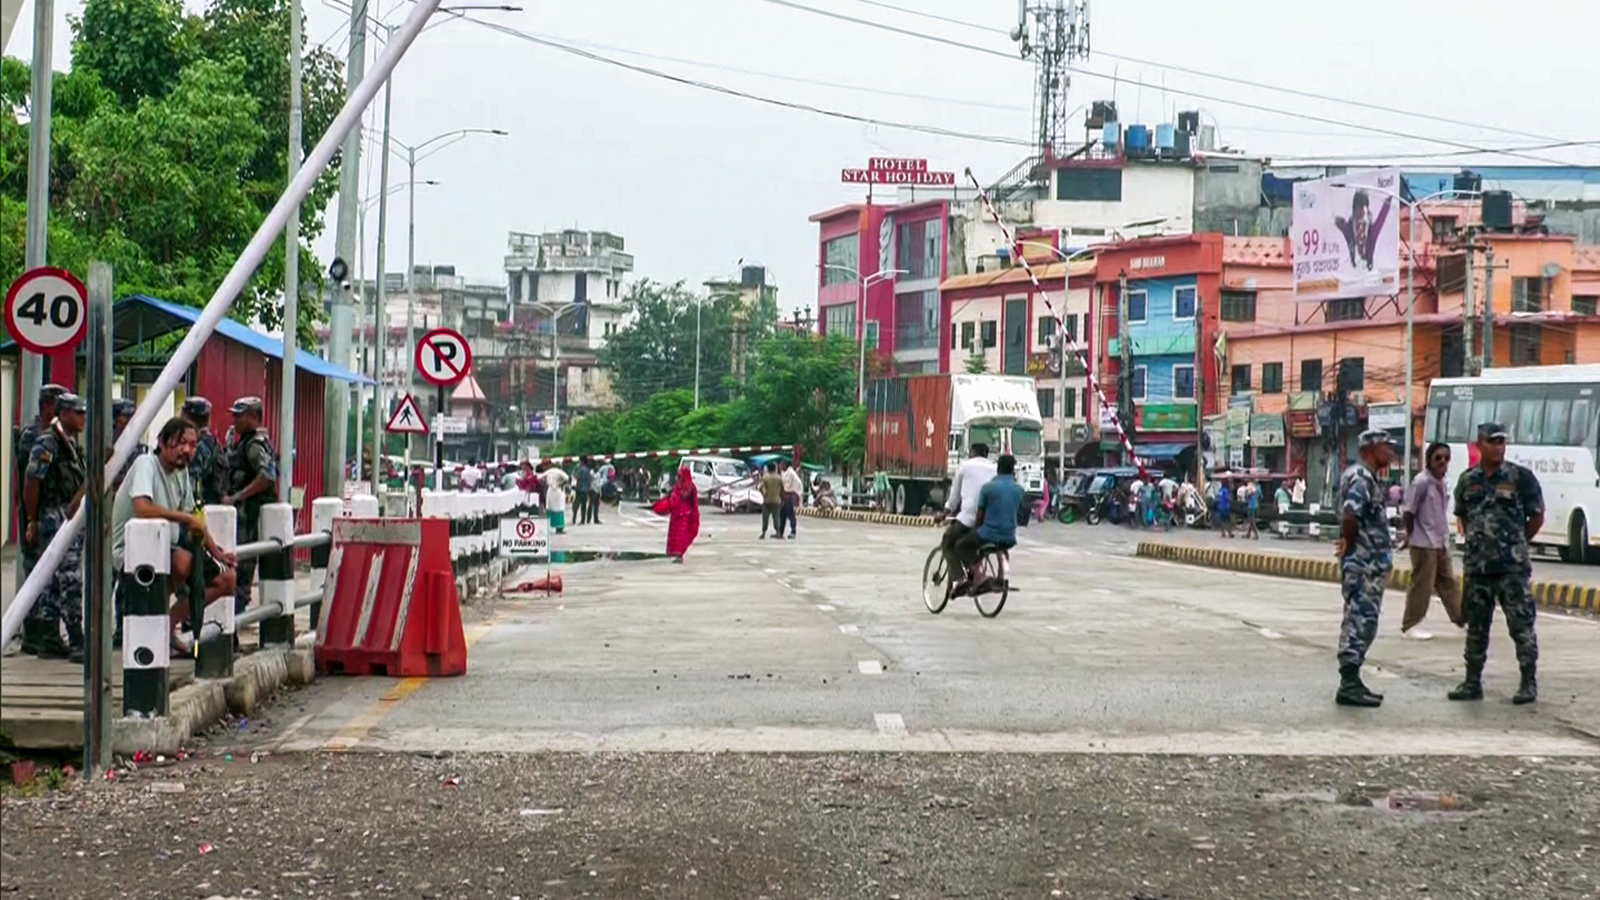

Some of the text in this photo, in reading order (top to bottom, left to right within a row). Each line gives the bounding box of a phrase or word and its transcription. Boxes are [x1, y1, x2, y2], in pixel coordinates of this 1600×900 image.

[873, 159, 925, 170] HOTEL
[843, 170, 952, 183] STAR HOLIDAY
[1303, 229, 1319, 256] 99
[17, 292, 79, 329] 40
[433, 342, 457, 373] P
[502, 540, 546, 548] NO PARKING
